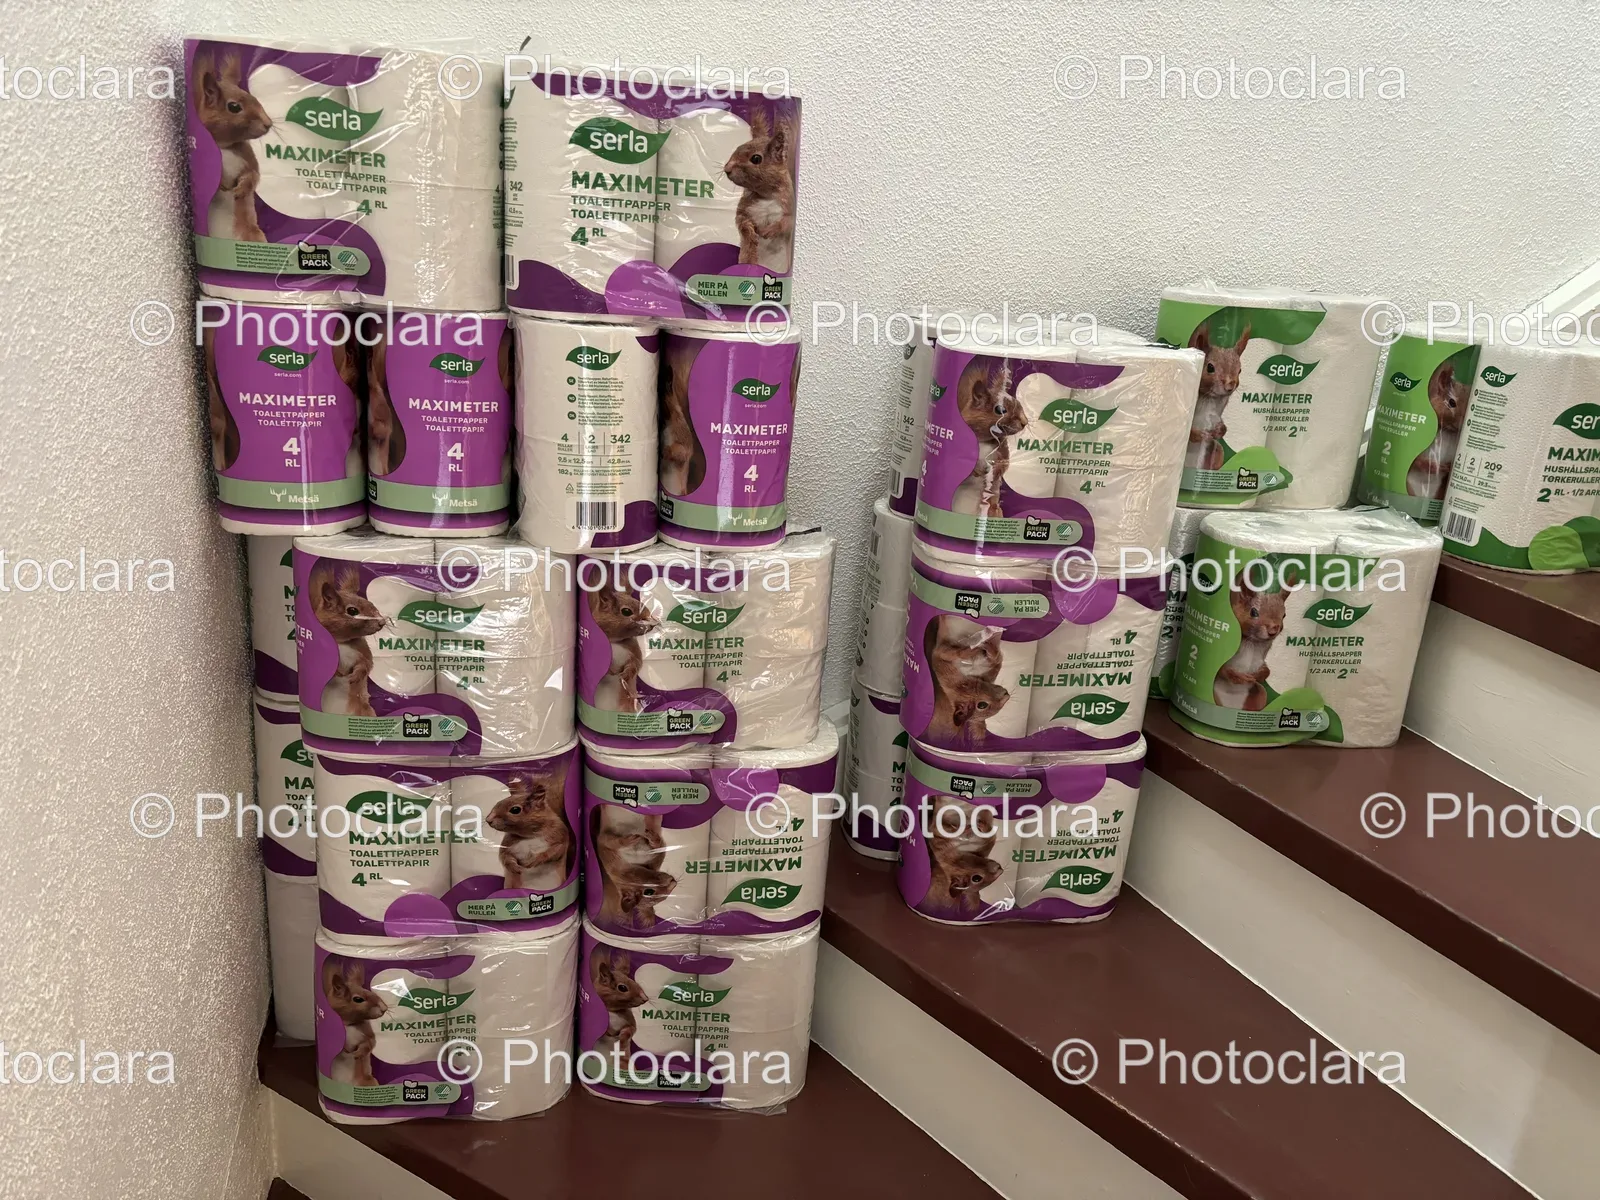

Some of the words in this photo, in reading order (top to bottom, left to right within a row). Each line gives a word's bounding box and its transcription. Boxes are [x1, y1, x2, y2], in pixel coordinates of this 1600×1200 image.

[305, 108, 361, 131] serla
[589, 129, 648, 154] serla
[265, 144, 386, 168] MAXIMETER
[295, 168, 387, 183] TOALETTPAPPER
[305, 180, 388, 195] TOALETTPAPIR
[509, 181, 523, 192] 342
[571, 171, 715, 199] MAXIMETER
[357, 200, 372, 216] 4
[374, 200, 388, 210] RL
[571, 195, 671, 212] TOALETTPAPPER
[571, 209, 660, 224] TOALETTPAPIR
[571, 226, 589, 246] 4
[592, 227, 607, 238] RL
[302, 259, 329, 268] PACK
[697, 281, 718, 289] MER
[697, 289, 728, 298] RULLEN
[764, 291, 782, 300] PACK
[269, 352, 305, 365] serla
[576, 352, 610, 364] serla
[440, 359, 473, 372] serla
[1269, 362, 1303, 377] serla
[1394, 376, 1411, 388] serla
[1484, 370, 1506, 384] serla
[742, 383, 771, 396] serla
[239, 392, 337, 407] MAXIMETER
[1241, 392, 1313, 404] MAXIMETER
[408, 398, 499, 413] MAXIMETER
[1253, 406, 1310, 415] HUSHÅLLSPAPPER
[253, 410, 326, 419] TOALETTPAPPER
[421, 415, 488, 424] TOALETTPAPPER
[903, 415, 915, 426] 342
[1053, 406, 1098, 425] serla
[1377, 404, 1427, 424] MAXIMETER
[258, 419, 322, 427] TOALETTPAPIR
[425, 424, 485, 433] TOALETTPAPIR
[710, 422, 788, 435] MAXIMETER
[1571, 415, 1600, 430] ser
[1288, 426, 1297, 437] 2
[561, 433, 569, 442] 4
[588, 435, 596, 444] 2
[610, 434, 631, 444] 342
[283, 438, 300, 455] 4
[447, 443, 464, 460] 4
[1016, 438, 1114, 455] MAXIMETER
[1382, 441, 1392, 455] 2
[1547, 446, 1600, 462] MAXIM
[285, 459, 300, 468] RL
[448, 464, 463, 472] RL
[1039, 457, 1111, 467] TOALETTPAPPER
[1484, 461, 1503, 472] 209
[743, 464, 758, 482] 4
[1045, 466, 1109, 476] TOALETTPAPIR
[744, 484, 757, 493] RL
[1079, 480, 1092, 494] 4
[1095, 480, 1106, 488] RL
[288, 493, 320, 504] Metsä
[1537, 488, 1552, 502] 2
[449, 498, 478, 508] Metsä
[743, 517, 768, 526] Metsä
[1026, 530, 1048, 539] PACK
[958, 595, 979, 603] PACK
[414, 607, 465, 624] serla
[682, 609, 727, 624] serla
[1316, 605, 1354, 621] serla
[648, 636, 745, 650] MAXIMETER
[1124, 630, 1137, 644] 4
[1286, 636, 1364, 647] MAXIMETER
[379, 638, 485, 651] MAXIMETER
[671, 652, 743, 661] TOALETTPAPPER
[1067, 649, 1135, 660] TOALETTPAPIR
[1190, 644, 1198, 660] 2
[404, 655, 485, 663] TOALETTPAPPER
[679, 660, 743, 668] TOALETTPAPIR
[1056, 660, 1133, 670] TOALETTPAPPER
[716, 671, 729, 683] 4
[1019, 672, 1132, 687] MAXIMETER
[1337, 668, 1348, 679] 2
[456, 676, 469, 690] 4
[1070, 700, 1116, 715] serla
[405, 722, 429, 730] GREEN
[406, 728, 429, 736] PACK
[669, 722, 691, 730] PACK
[361, 798, 415, 816] serla
[1113, 809, 1124, 823] 4
[791, 818, 804, 831] 4
[349, 830, 478, 845] MAXIMETER
[732, 836, 804, 845] TOALETTPAPIR
[1047, 836, 1119, 846] TOALETTPAPPER
[350, 848, 439, 858] TOALETTPAPPER
[722, 846, 803, 855] TOALETTPAPPER
[1012, 845, 1116, 863] MAXIMETER
[350, 859, 430, 867] TOALETTPAPIR
[685, 856, 801, 874] MAXIMETER
[351, 872, 367, 887] 4
[1060, 872, 1101, 889] serla
[741, 885, 787, 901] serla
[468, 909, 496, 917] RULLEN
[531, 904, 552, 913] PACK
[413, 994, 458, 1010] serla
[672, 989, 714, 1003] serla
[642, 1009, 730, 1022] MAXIMETER
[380, 1014, 477, 1031] MAXIMETER
[662, 1024, 730, 1033] TOALETTPAPPER
[404, 1027, 477, 1038] TOALETTPAPPER
[669, 1032, 729, 1040] TOALETTPAPIR
[704, 1043, 716, 1053] 4
[405, 1092, 426, 1100] PACK
